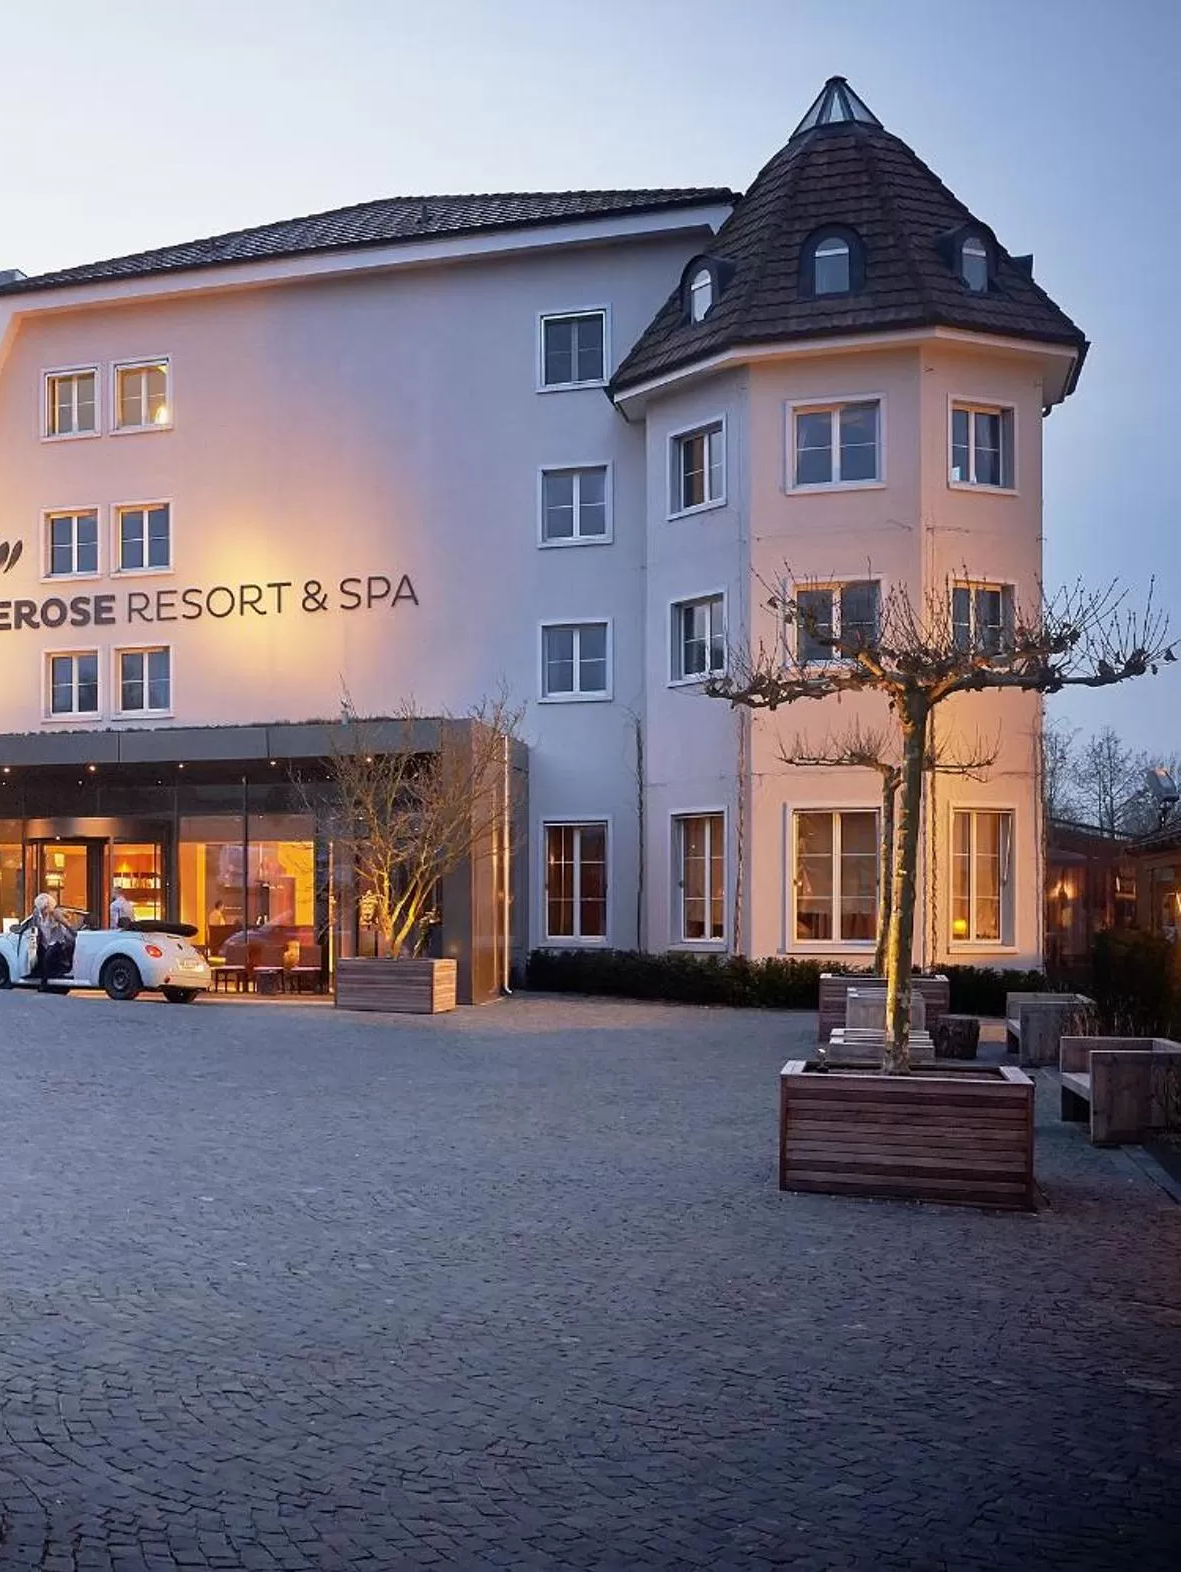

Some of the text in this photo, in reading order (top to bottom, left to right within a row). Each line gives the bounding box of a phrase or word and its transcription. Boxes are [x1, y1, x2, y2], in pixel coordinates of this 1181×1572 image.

[127, 582, 292, 624] RESORT
[301, 579, 328, 612] &
[339, 574, 419, 610] SPA
